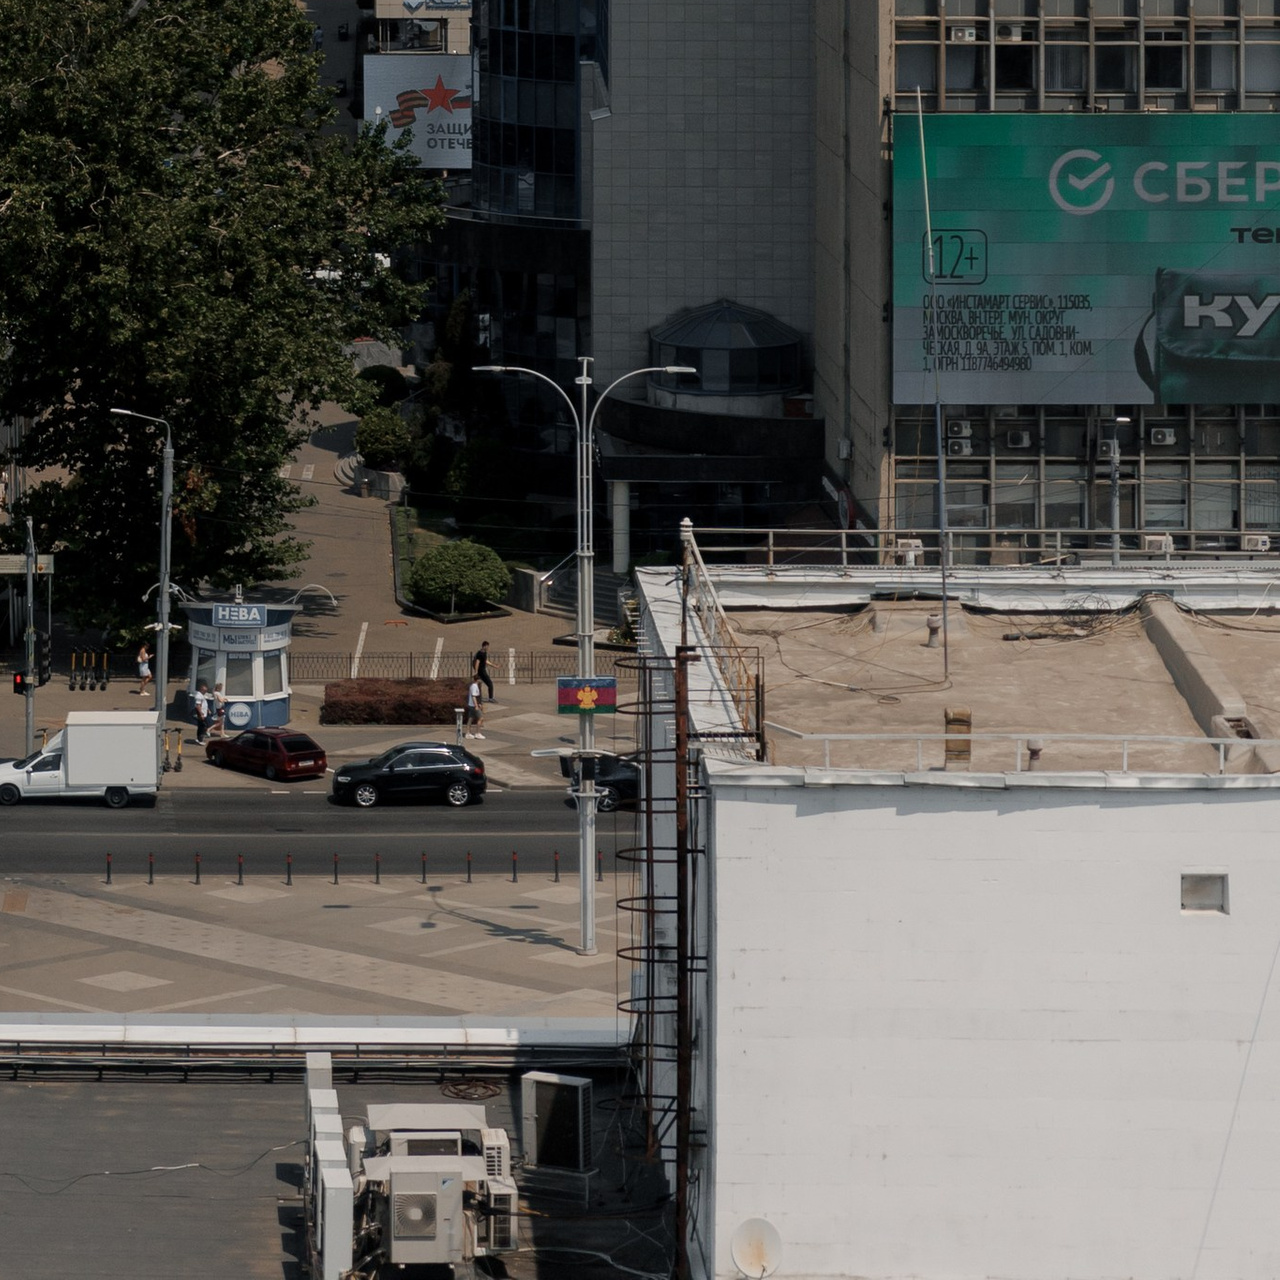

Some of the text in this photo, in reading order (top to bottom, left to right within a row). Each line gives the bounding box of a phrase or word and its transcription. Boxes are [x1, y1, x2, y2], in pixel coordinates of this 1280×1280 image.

[426, 123, 472, 136] ЗАЩИ
[426, 137, 473, 150] ОТЕЧЕ
[1133, 161, 1280, 203] СБЕР
[1230, 227, 1280, 244] те
[933, 234, 979, 279] 12+
[923, 294, 1093, 312] ООО «ИНСТАМАРТ СЕРВИС», 115035,
[1008, 310, 1032, 325] МУН.
[1035, 310, 1066, 325] ОКРУГ
[1183, 294, 1280, 337] КУ
[1029, 326, 1080, 342] САДОВНИ-
[993, 341, 1020, 356] ЭТАЖ
[1032, 341, 1057, 356] ПОМ.
[1059, 341, 1067, 358] 1,
[1070, 341, 1094, 356] КОМ.
[922, 356, 932, 373] 1,
[933, 356, 959, 371] ОГРН
[218, 606, 261, 620] НЕВА
